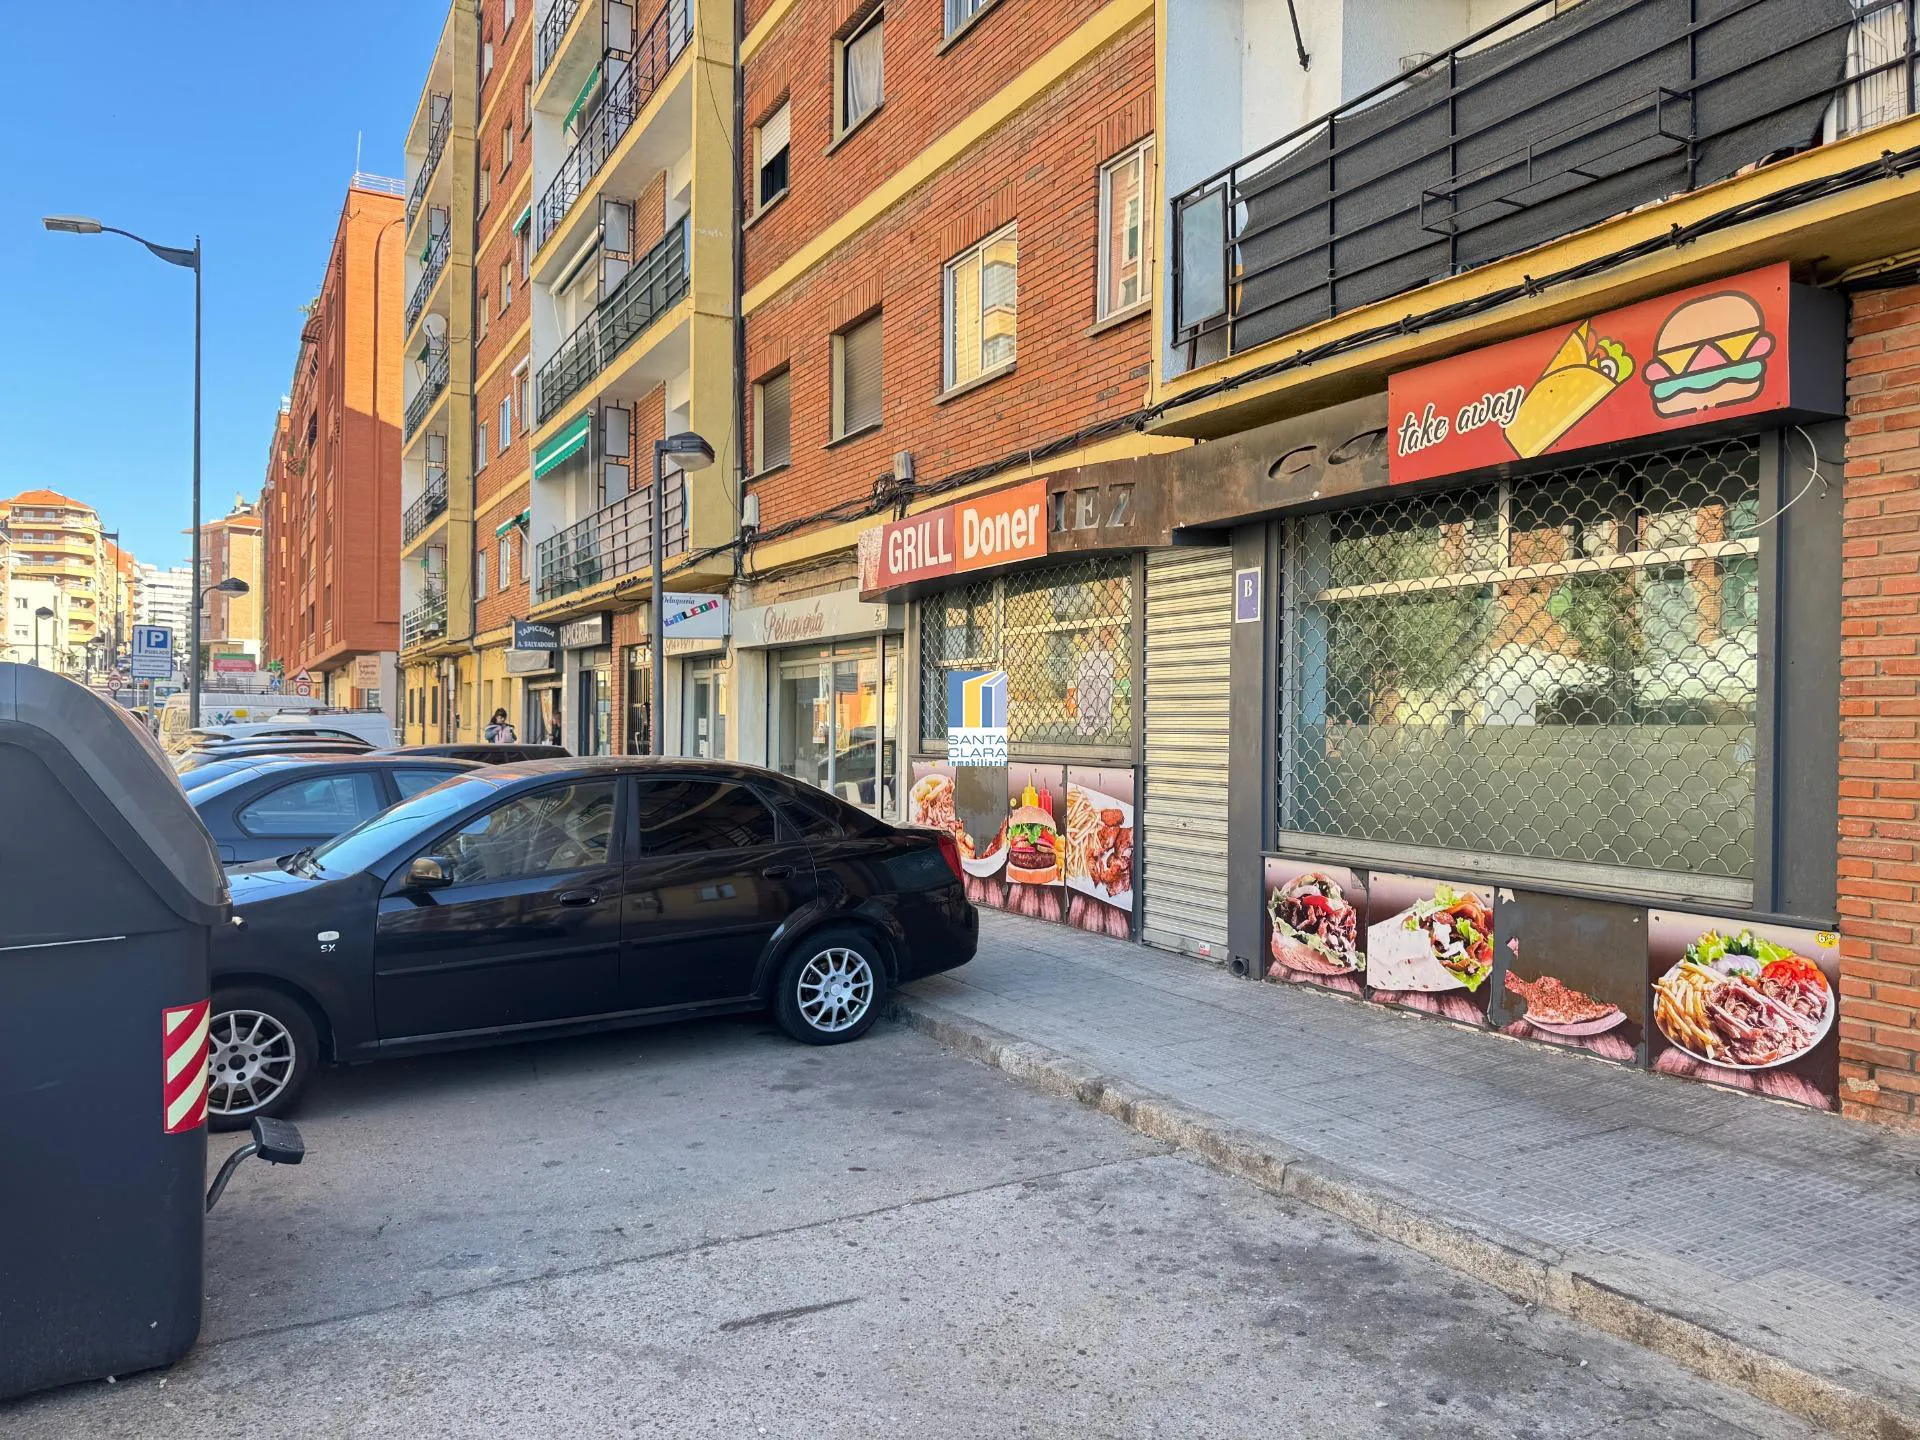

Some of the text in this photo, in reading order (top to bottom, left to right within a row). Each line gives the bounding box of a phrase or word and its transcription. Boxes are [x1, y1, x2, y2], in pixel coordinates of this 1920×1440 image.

[1399, 386, 1523, 456] take away
[888, 504, 1040, 575] GRILL Doner
[1244, 579, 1253, 598] B
[150, 631, 165, 647] P
[320, 943, 336, 952] SX
